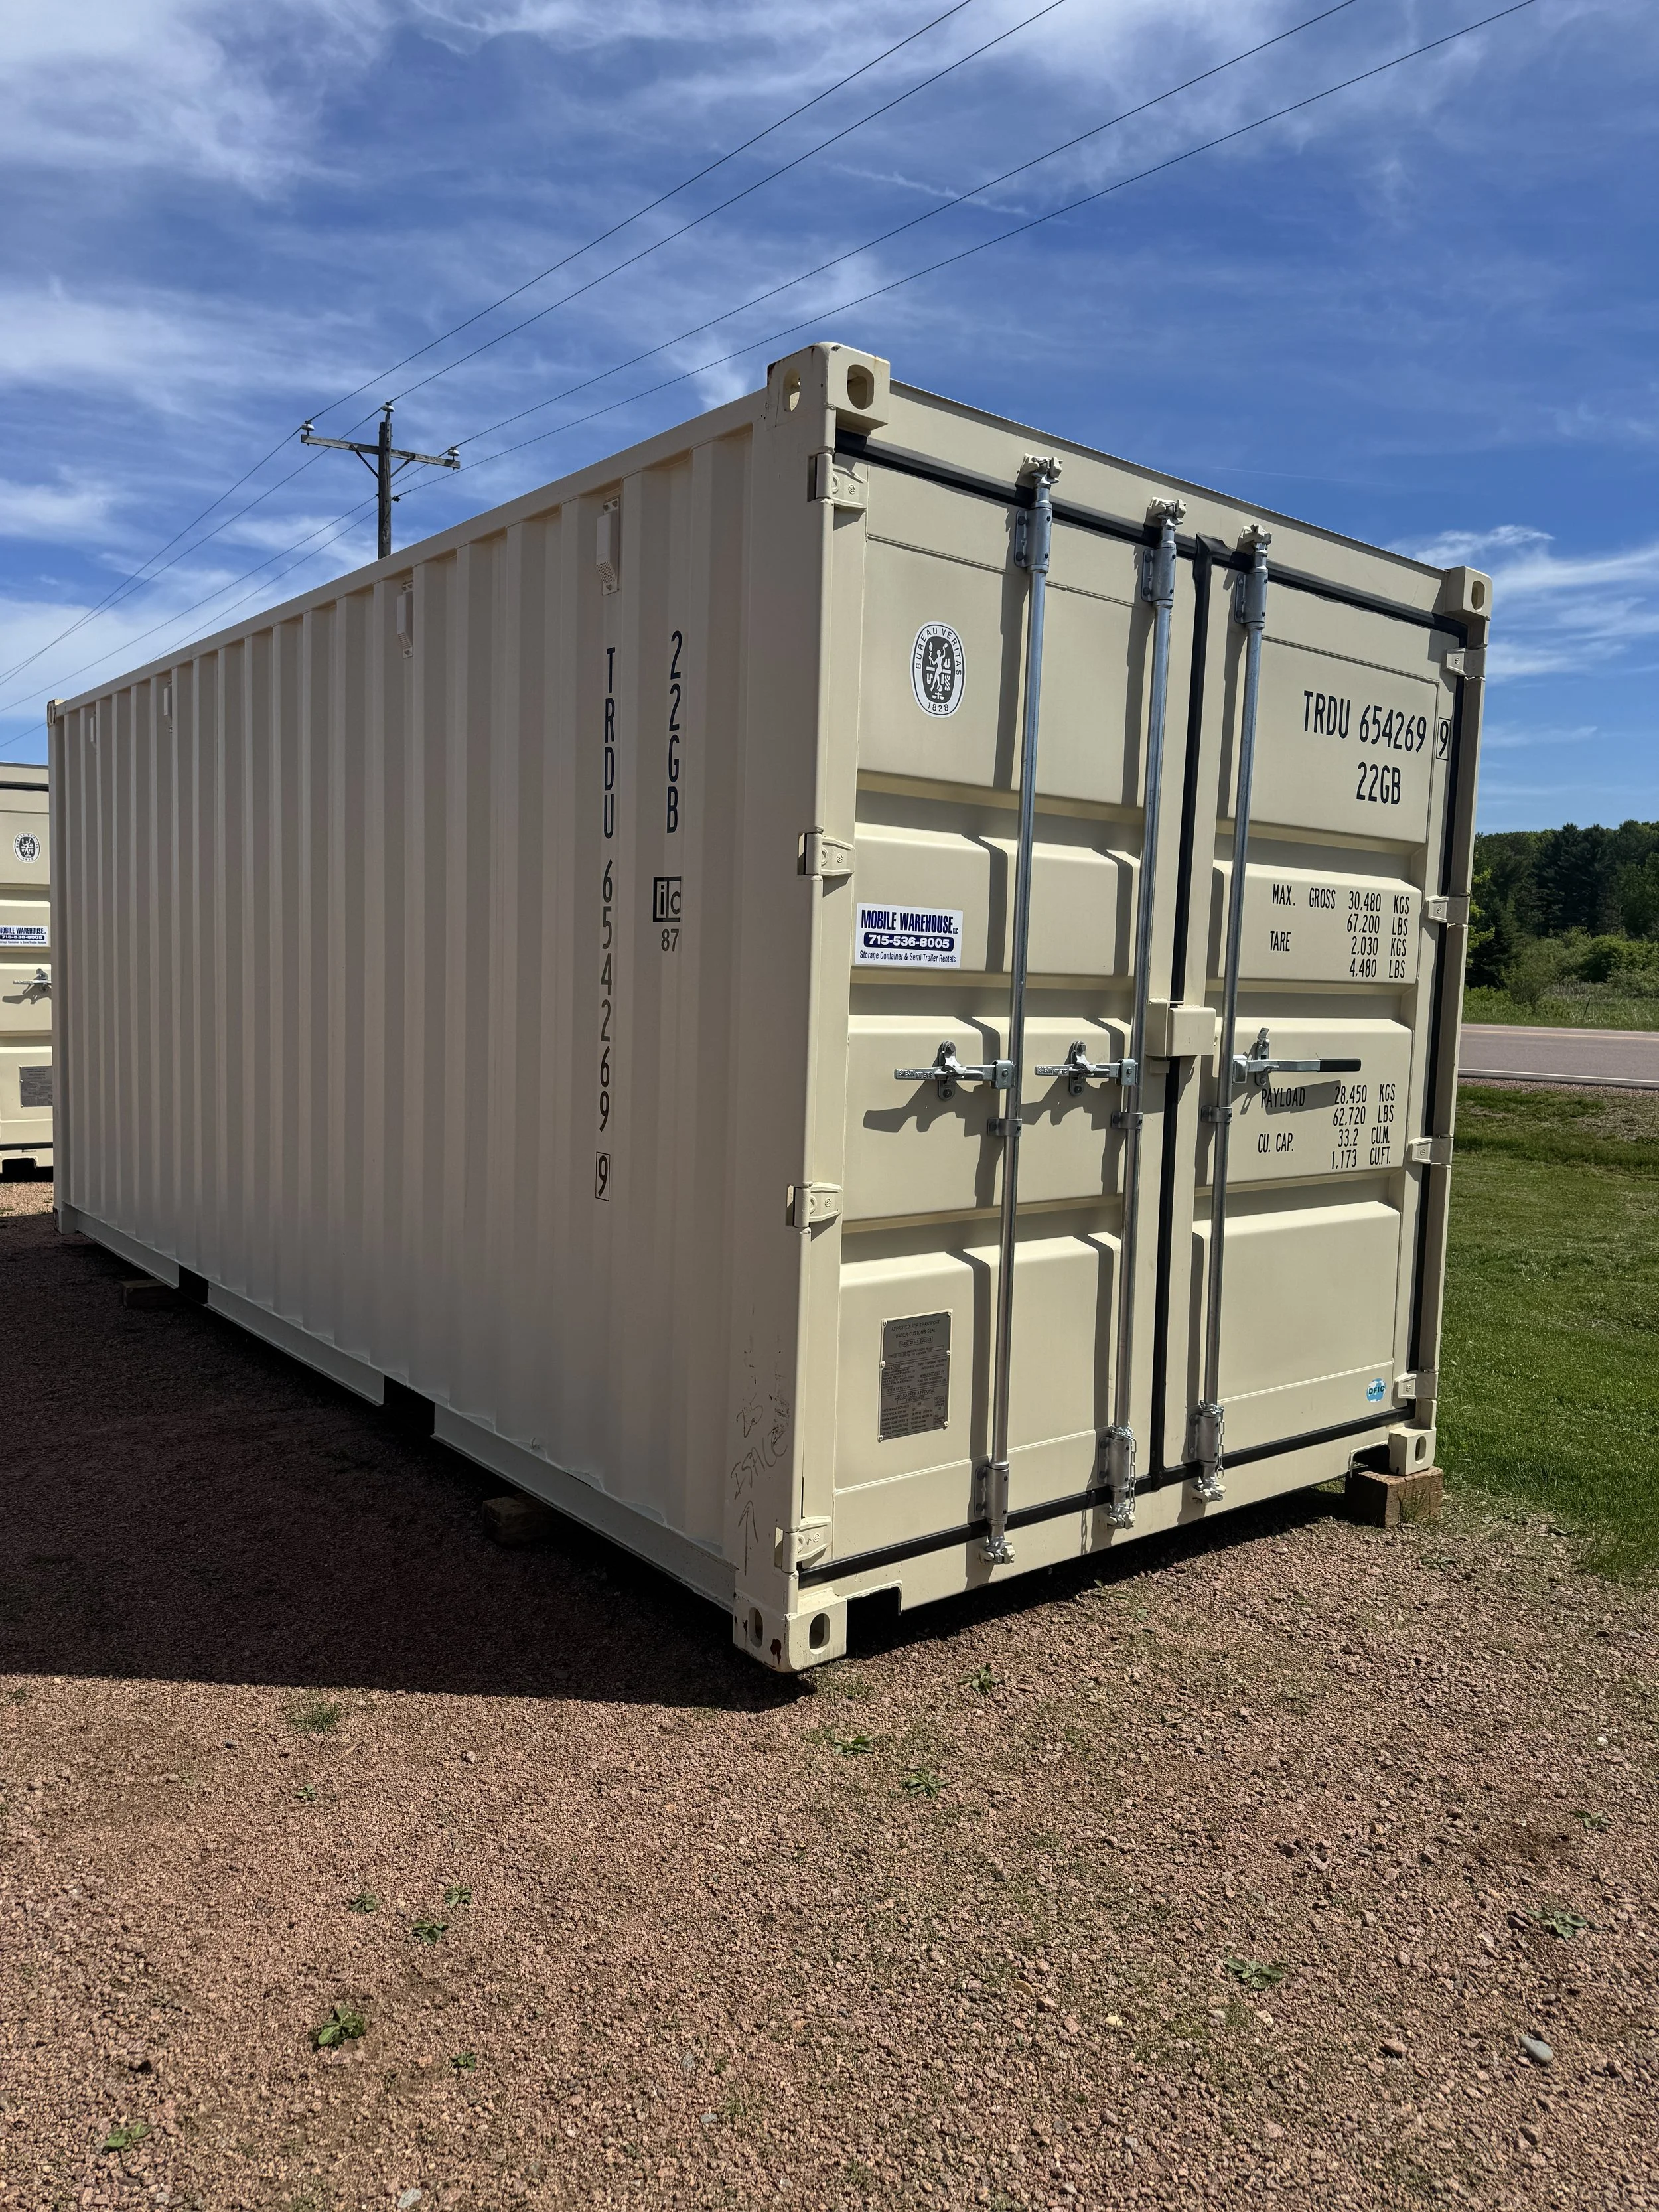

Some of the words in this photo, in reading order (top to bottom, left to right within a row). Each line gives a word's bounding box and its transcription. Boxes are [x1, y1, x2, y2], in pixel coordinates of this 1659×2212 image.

[915, 627, 938, 670] BUREAU
[942, 628, 962, 676] VERITAS
[928, 702, 949, 712] 1828
[666, 630, 682, 834] 22GB
[1303, 690, 1351, 739] TRDU
[1359, 704, 1427, 753] 654269
[1438, 720, 1449, 757] 9
[603, 646, 616, 840] TRDU
[1356, 761, 1401, 805] 22GB
[1272, 883, 1295, 906] MAX.
[1309, 887, 1336, 909] GROSS
[1393, 895, 1410, 915] KGS
[861, 909, 897, 930] MOBILE
[900, 912, 953, 934] WAREHOUSE
[1392, 917, 1408, 936] LBS
[660, 928, 680, 952] 87
[868, 934, 950, 949] 715-536-8005
[1270, 930, 1291, 952] TARE
[1390, 938, 1407, 957] KGS
[859, 950, 879, 961] Storage
[880, 951, 903, 960] Container
[909, 952, 922, 961] Semi
[923, 953, 938, 962] Trailer
[939, 954, 956, 963] Rentals
[1388, 959, 1406, 978] LBS
[599, 859, 613, 1132] 654269
[1261, 1086, 1306, 1108] PAYLOAD
[1379, 1083, 1396, 1102] KGS
[1378, 1104, 1394, 1124] LBS
[1258, 1134, 1271, 1153] CU.
[1275, 1132, 1294, 1153] CAP.
[1338, 1128, 1358, 1147] 33.2
[597, 1155, 609, 1197] 9
[1368, 1385, 1385, 1395] DFIC
